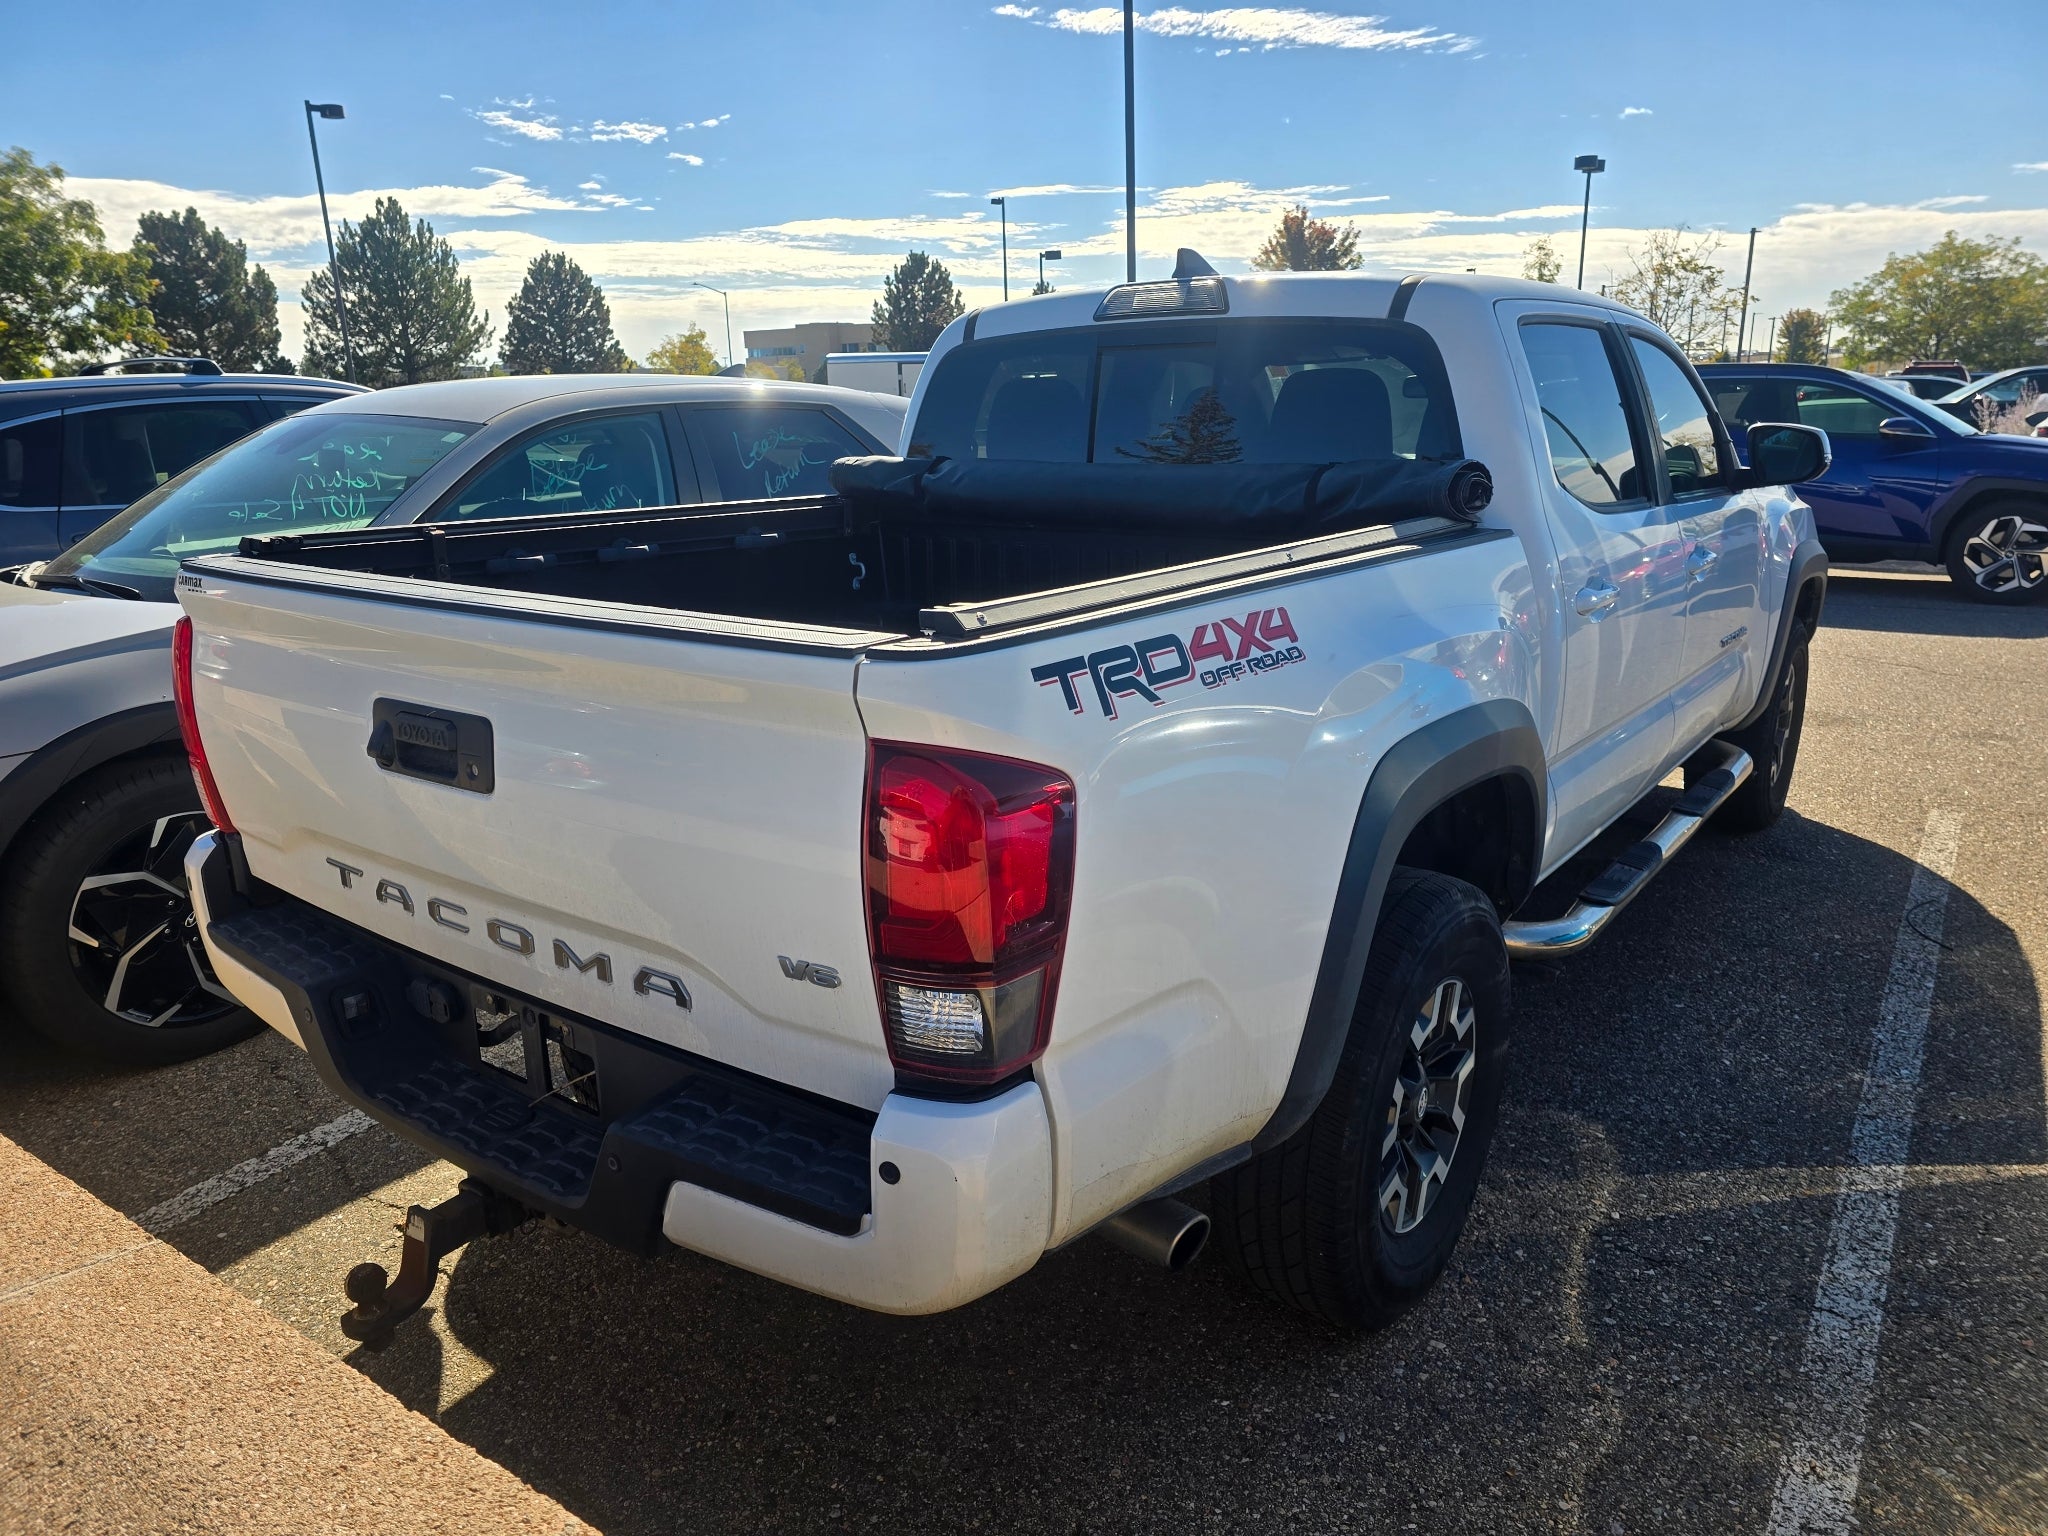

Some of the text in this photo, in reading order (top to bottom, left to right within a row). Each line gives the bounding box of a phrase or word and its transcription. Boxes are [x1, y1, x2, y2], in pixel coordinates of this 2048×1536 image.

[1030, 606, 1300, 721] TRD 4X4
[1200, 645, 1307, 690] OFF ROAD
[398, 722, 448, 747] TOYOTA
[326, 856, 694, 1012] TACOMA
[777, 955, 842, 989] V6
